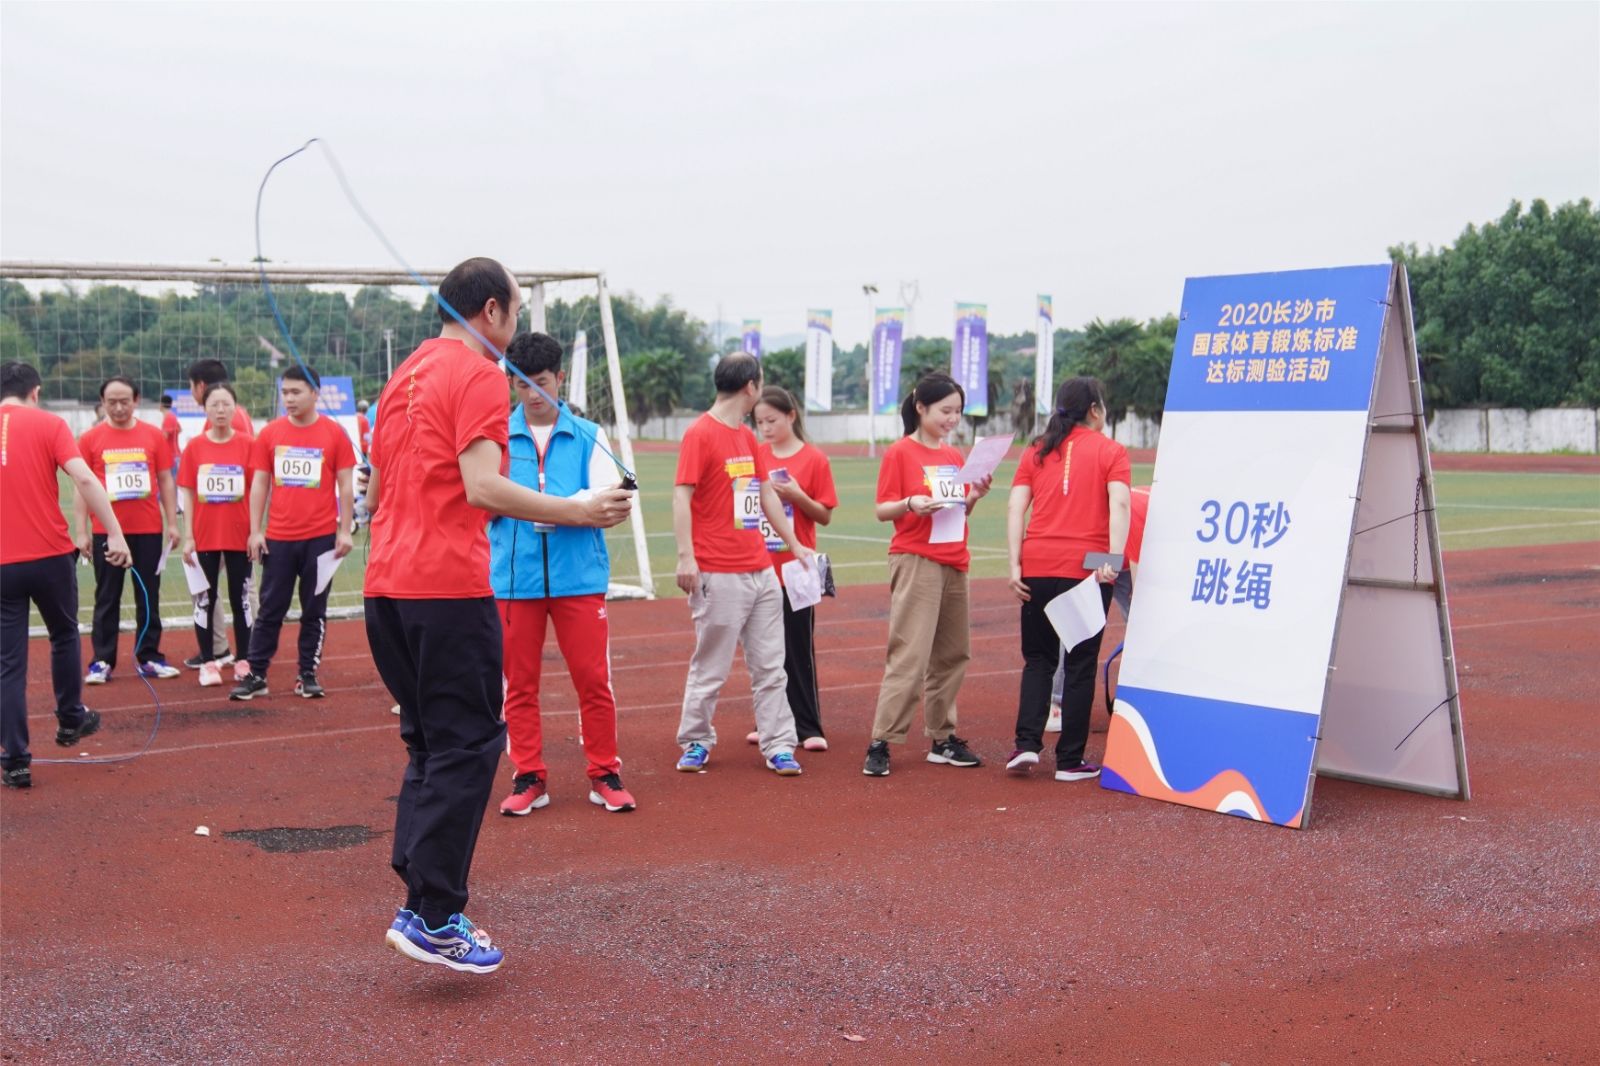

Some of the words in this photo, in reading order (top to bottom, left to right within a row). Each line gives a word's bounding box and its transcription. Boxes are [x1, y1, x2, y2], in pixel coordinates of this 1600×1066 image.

[1218, 298, 1337, 328] 2020长沙市
[1191, 327, 1358, 357] 国家体育锻炼标准
[1205, 356, 1331, 385] 达标测验活动
[117, 473, 143, 489] 105
[282, 459, 312, 476] 050
[206, 477, 235, 493] 051
[1195, 499, 1292, 550] 30秒
[1191, 558, 1274, 611] 跳绳
